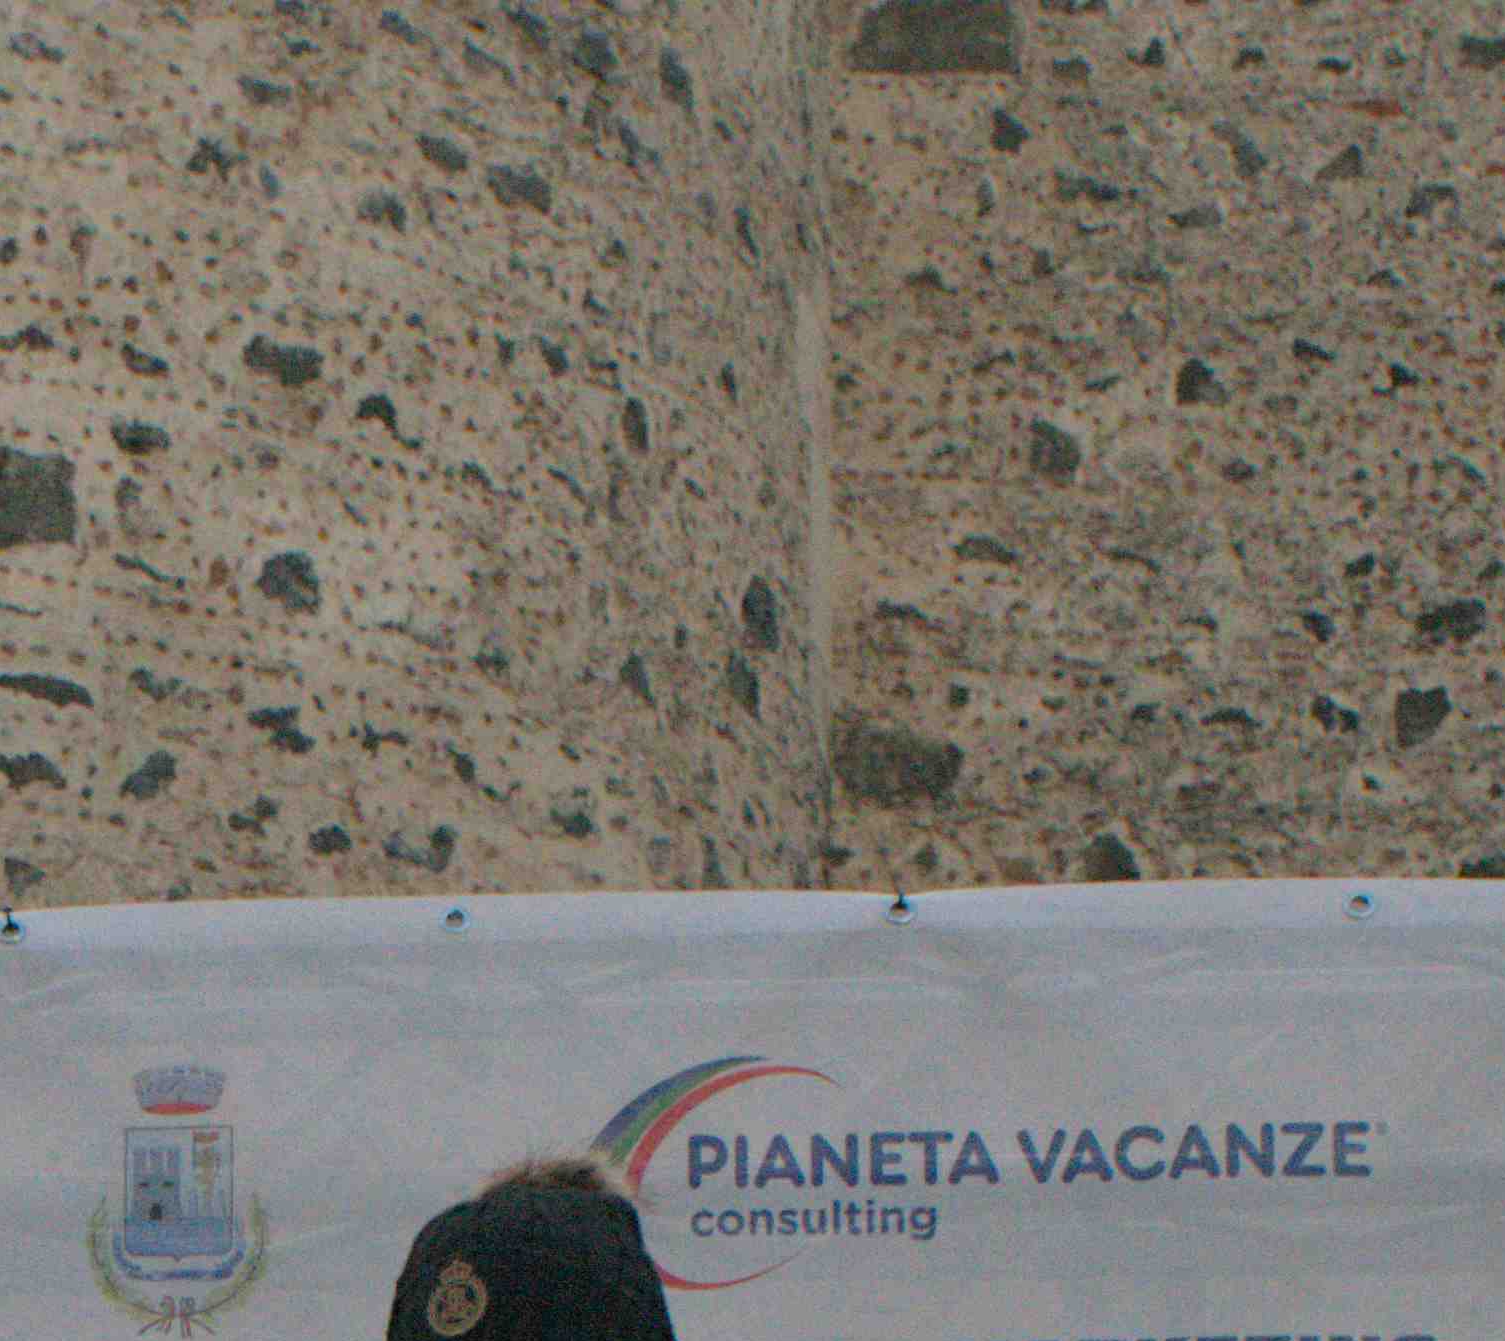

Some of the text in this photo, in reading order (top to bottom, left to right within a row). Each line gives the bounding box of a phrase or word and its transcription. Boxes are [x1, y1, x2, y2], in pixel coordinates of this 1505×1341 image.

[687, 1119, 1374, 1190] PIANETA VACANZE
[689, 1199, 939, 1241] consulting
